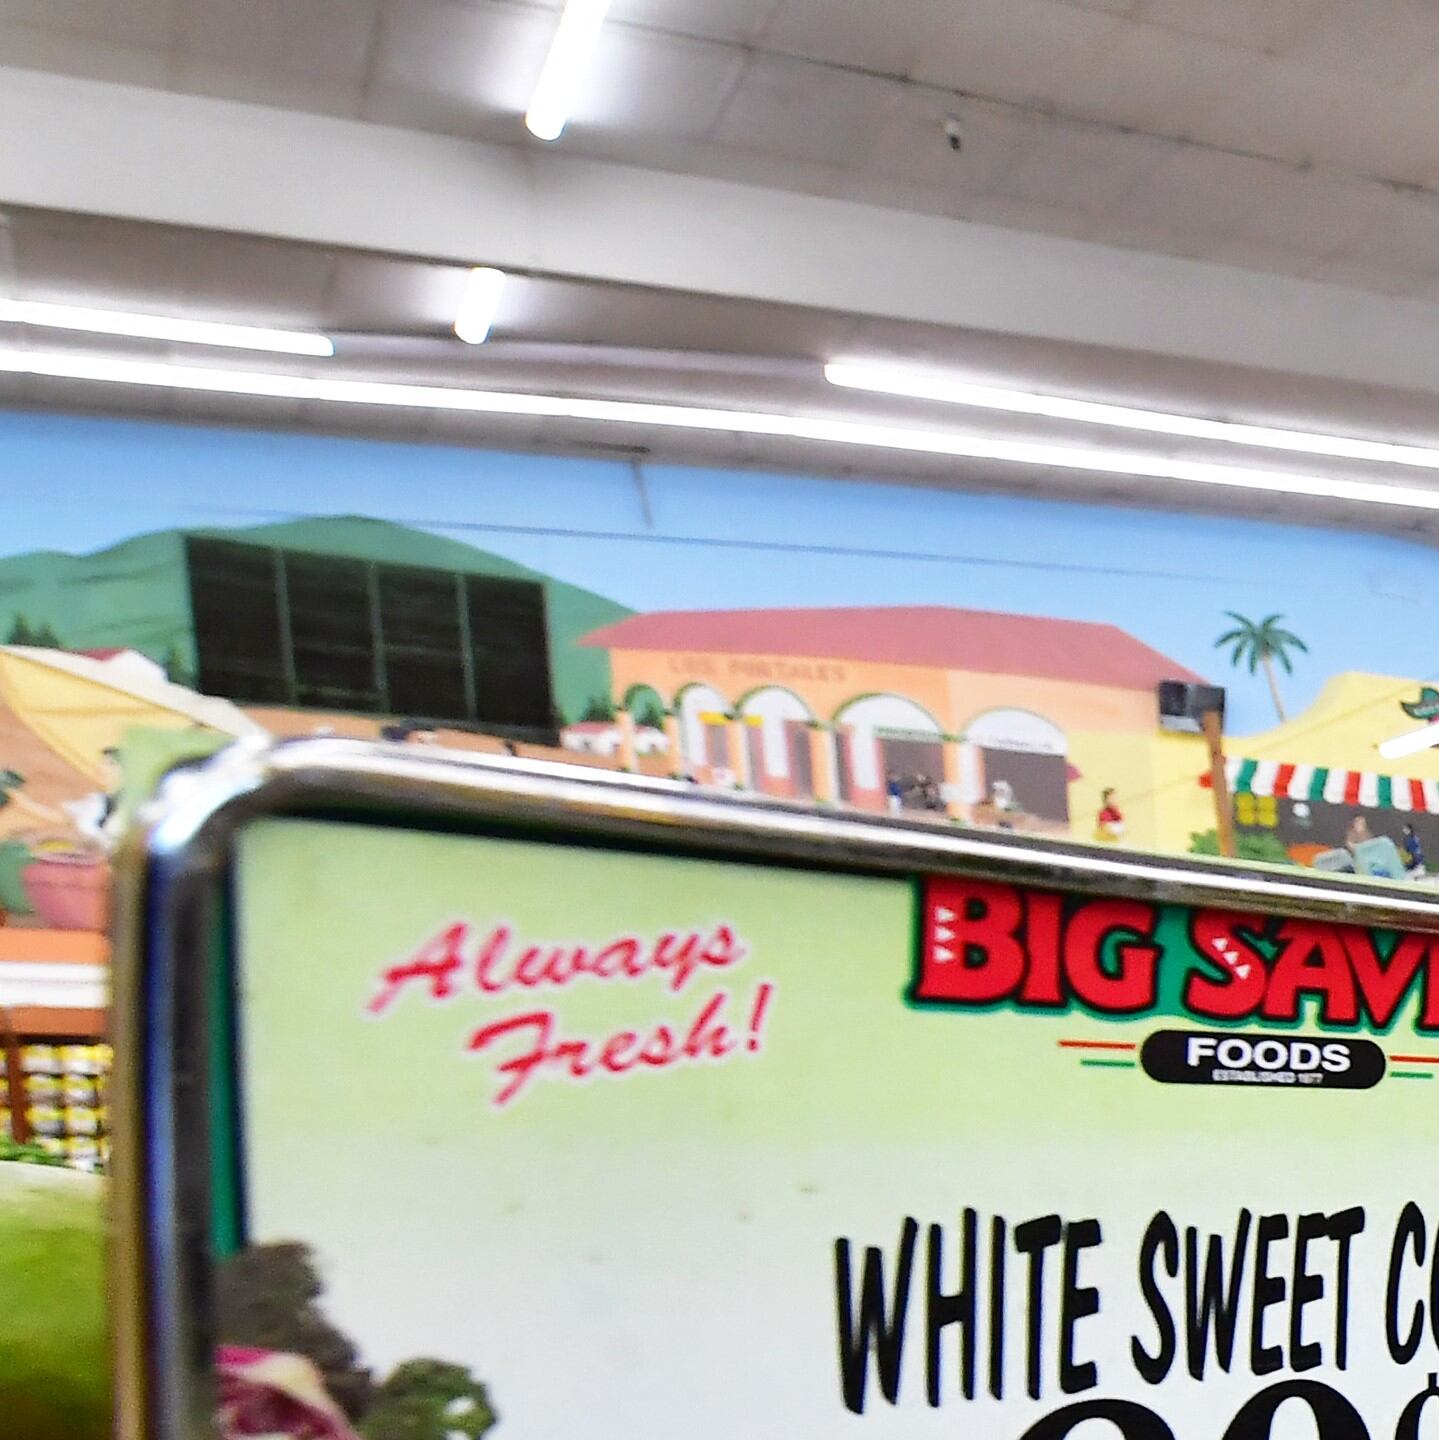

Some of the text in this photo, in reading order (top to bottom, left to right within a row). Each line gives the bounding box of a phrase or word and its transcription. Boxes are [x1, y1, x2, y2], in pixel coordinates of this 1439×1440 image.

[366, 921, 748, 1015] Always
[908, 873, 1163, 1018] BIG
[465, 982, 776, 1107] Fresh!
[1187, 1036, 1352, 1073] FOODS
[833, 1206, 1103, 1415] WHITE
[1131, 1205, 1367, 1386] SWEET
